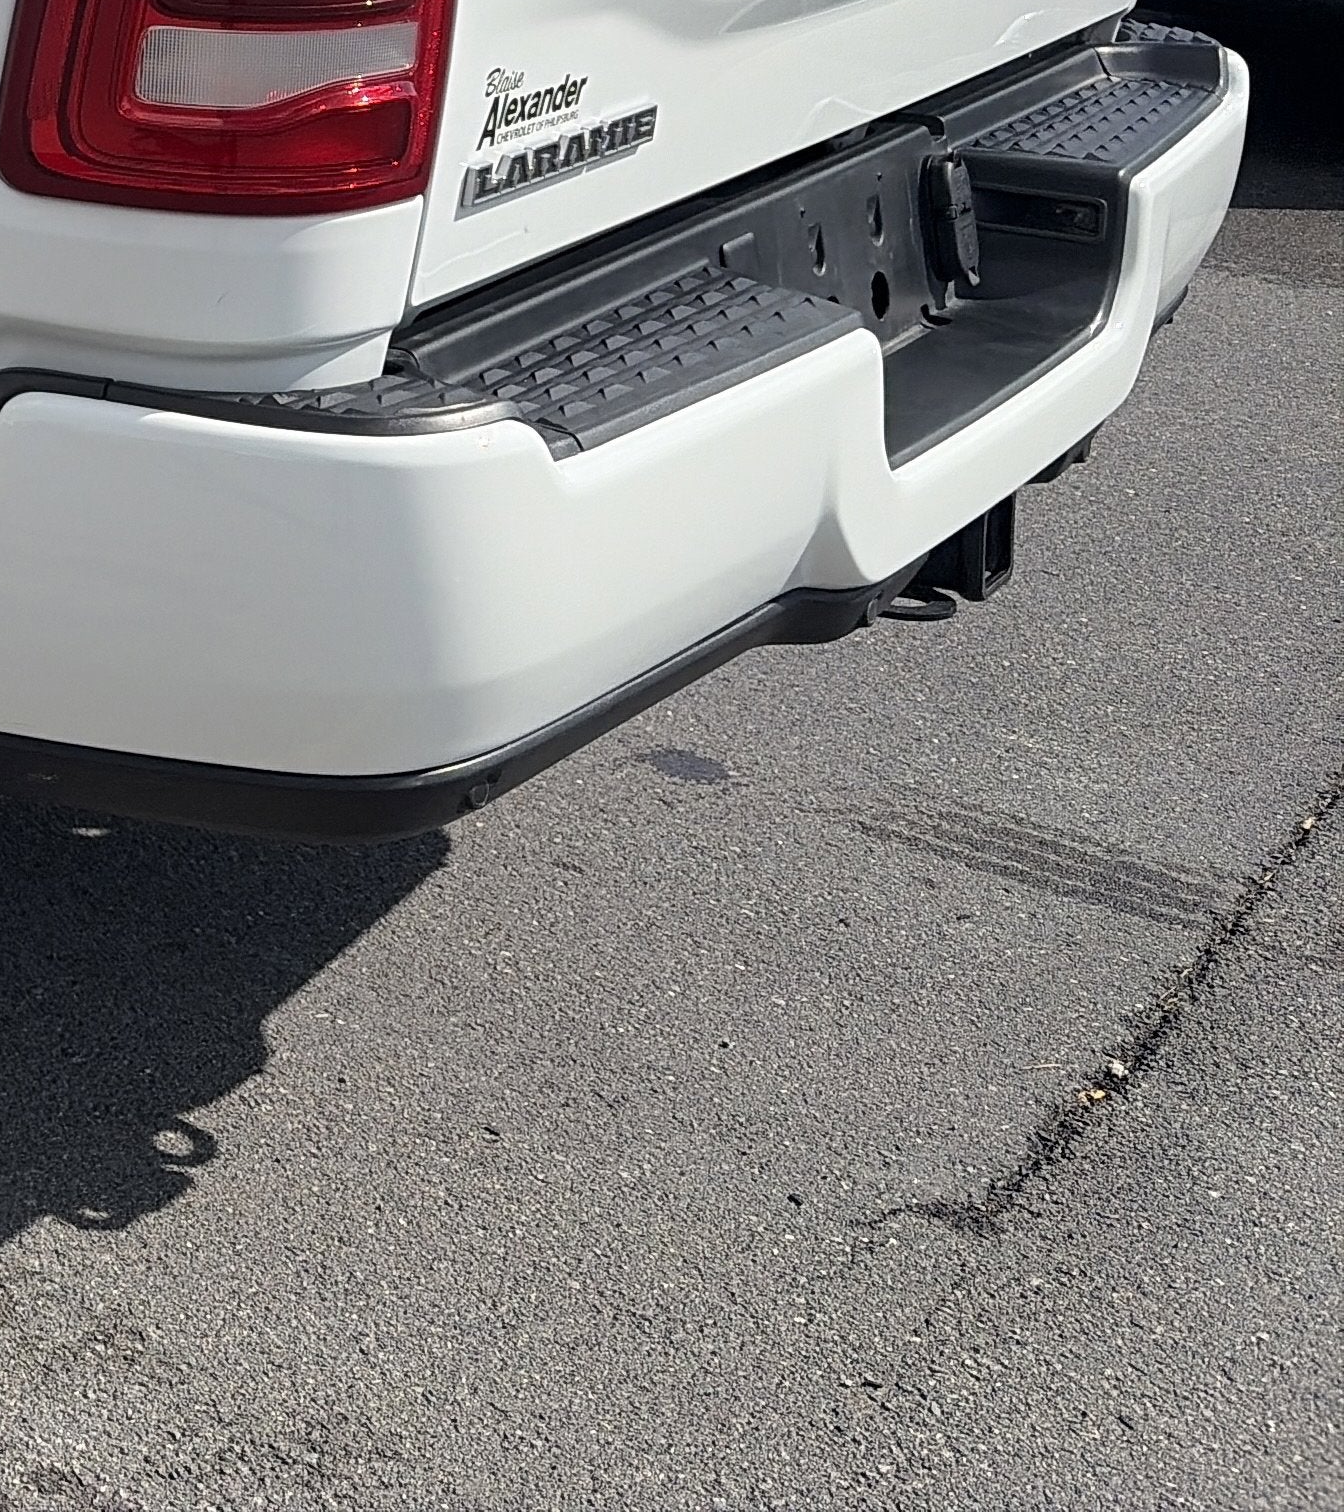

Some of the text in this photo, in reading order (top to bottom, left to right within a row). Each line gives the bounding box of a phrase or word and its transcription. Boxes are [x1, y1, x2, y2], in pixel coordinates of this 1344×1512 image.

[484, 67, 525, 97] Blaise
[476, 74, 589, 151] Alexander
[496, 127, 535, 145] CHEVROLET
[457, 104, 658, 210] LARAMIE
